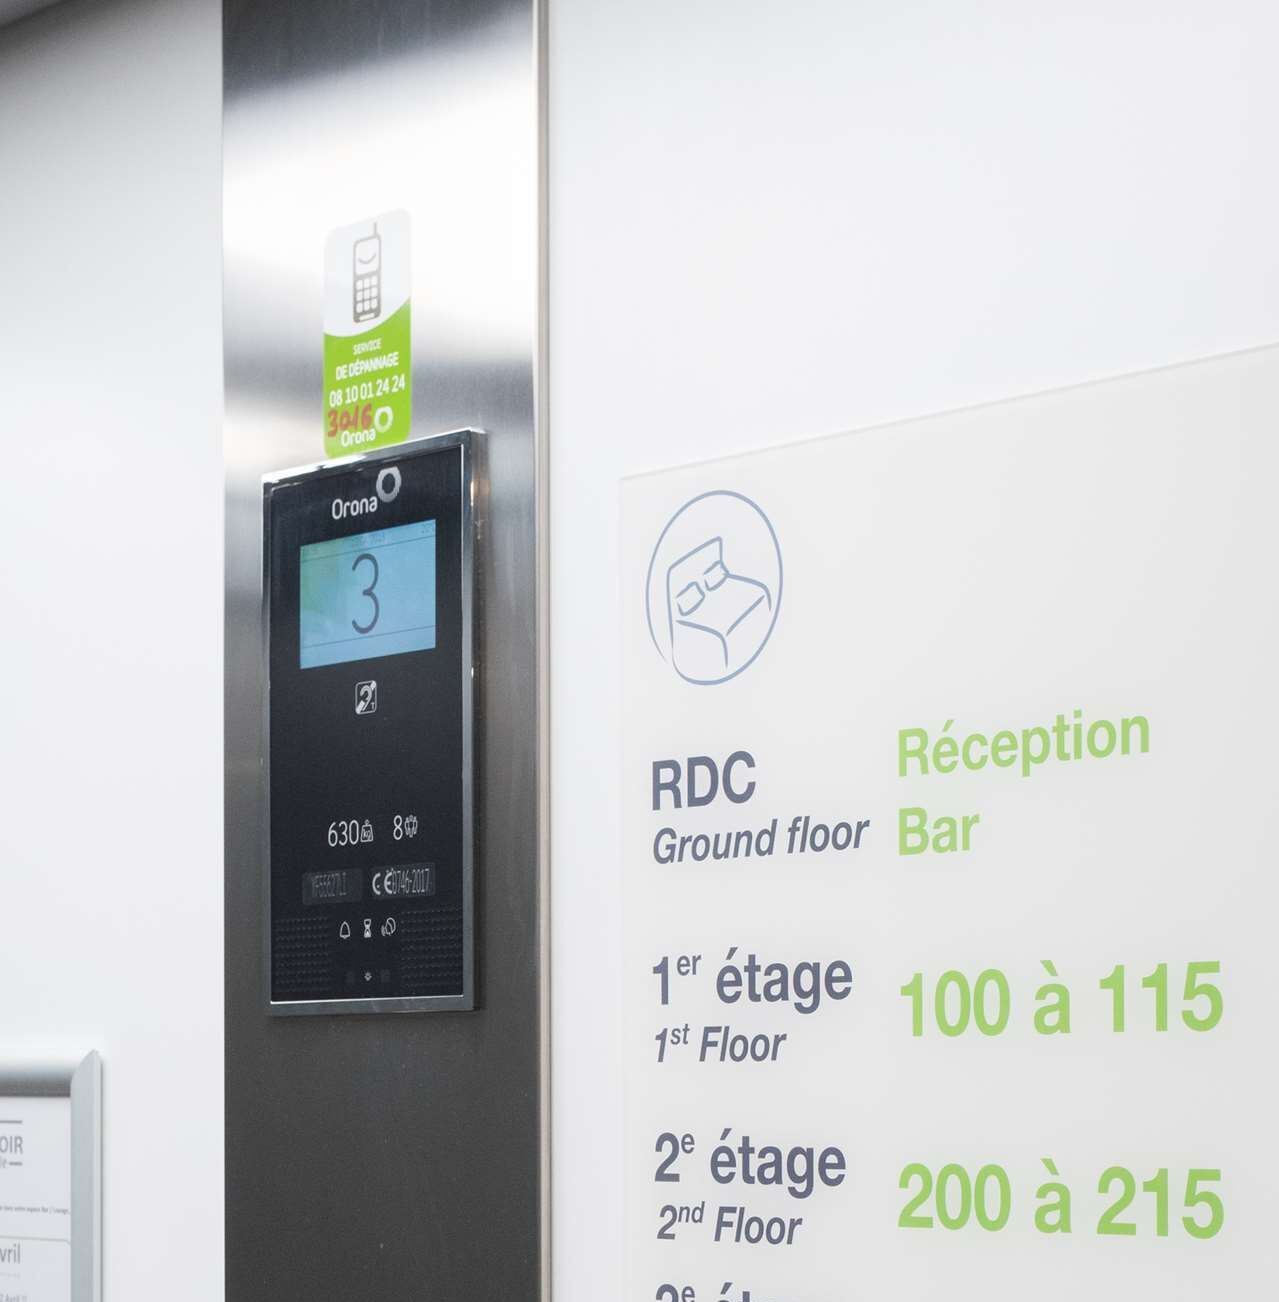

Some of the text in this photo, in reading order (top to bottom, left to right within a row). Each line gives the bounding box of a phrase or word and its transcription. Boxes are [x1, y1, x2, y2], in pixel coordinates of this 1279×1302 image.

[336, 352, 399, 381] DE DÉPANNAGE
[353, 337, 381, 355] SERVICE
[329, 373, 405, 407] 08 10 01 24 24
[342, 428, 376, 447] Orona
[332, 496, 378, 519] Orona
[352, 553, 379, 634] 3
[897, 709, 1150, 778] Réception
[653, 751, 756, 810] RDC
[328, 820, 359, 847] 630
[393, 815, 403, 840] 8
[654, 816, 870, 864] Ground floor
[897, 807, 981, 856] Bar
[653, 947, 852, 1014] 1er étage
[900, 960, 1223, 1038] 100 à 115
[655, 1024, 787, 1062] 1st Floor
[655, 1128, 846, 1199] 2e étage
[897, 1157, 1225, 1240] 200 à 215
[657, 1201, 803, 1245] 2nd Floor
